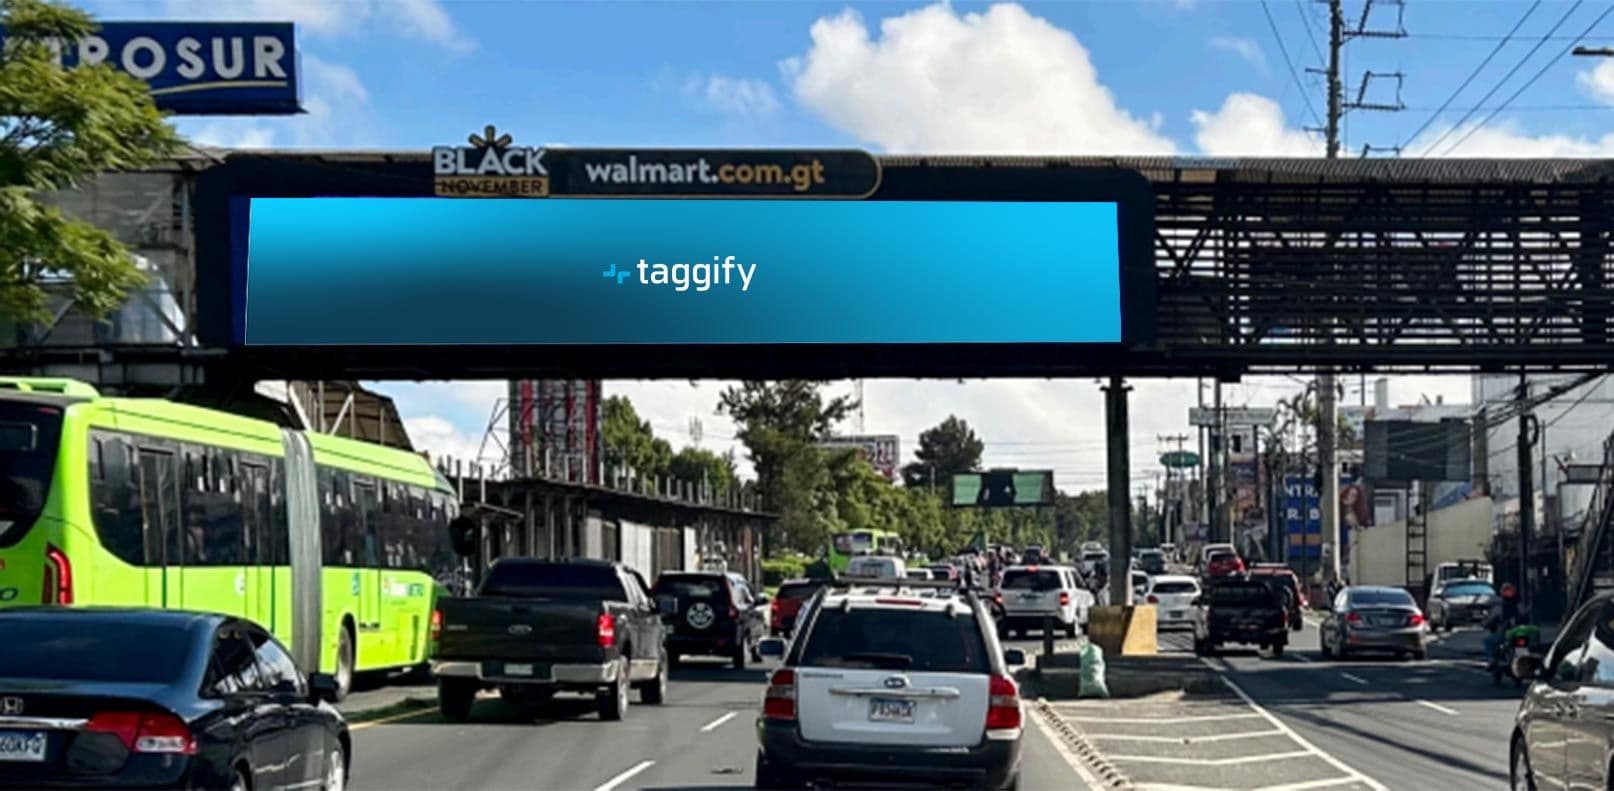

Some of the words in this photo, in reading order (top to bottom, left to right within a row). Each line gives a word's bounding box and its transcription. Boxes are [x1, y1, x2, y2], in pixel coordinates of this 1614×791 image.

[434, 147, 548, 175] BLACK
[586, 157, 825, 191] walmart.com.gt
[441, 179, 543, 194] NOVEMBER
[636, 256, 757, 291] taggify
